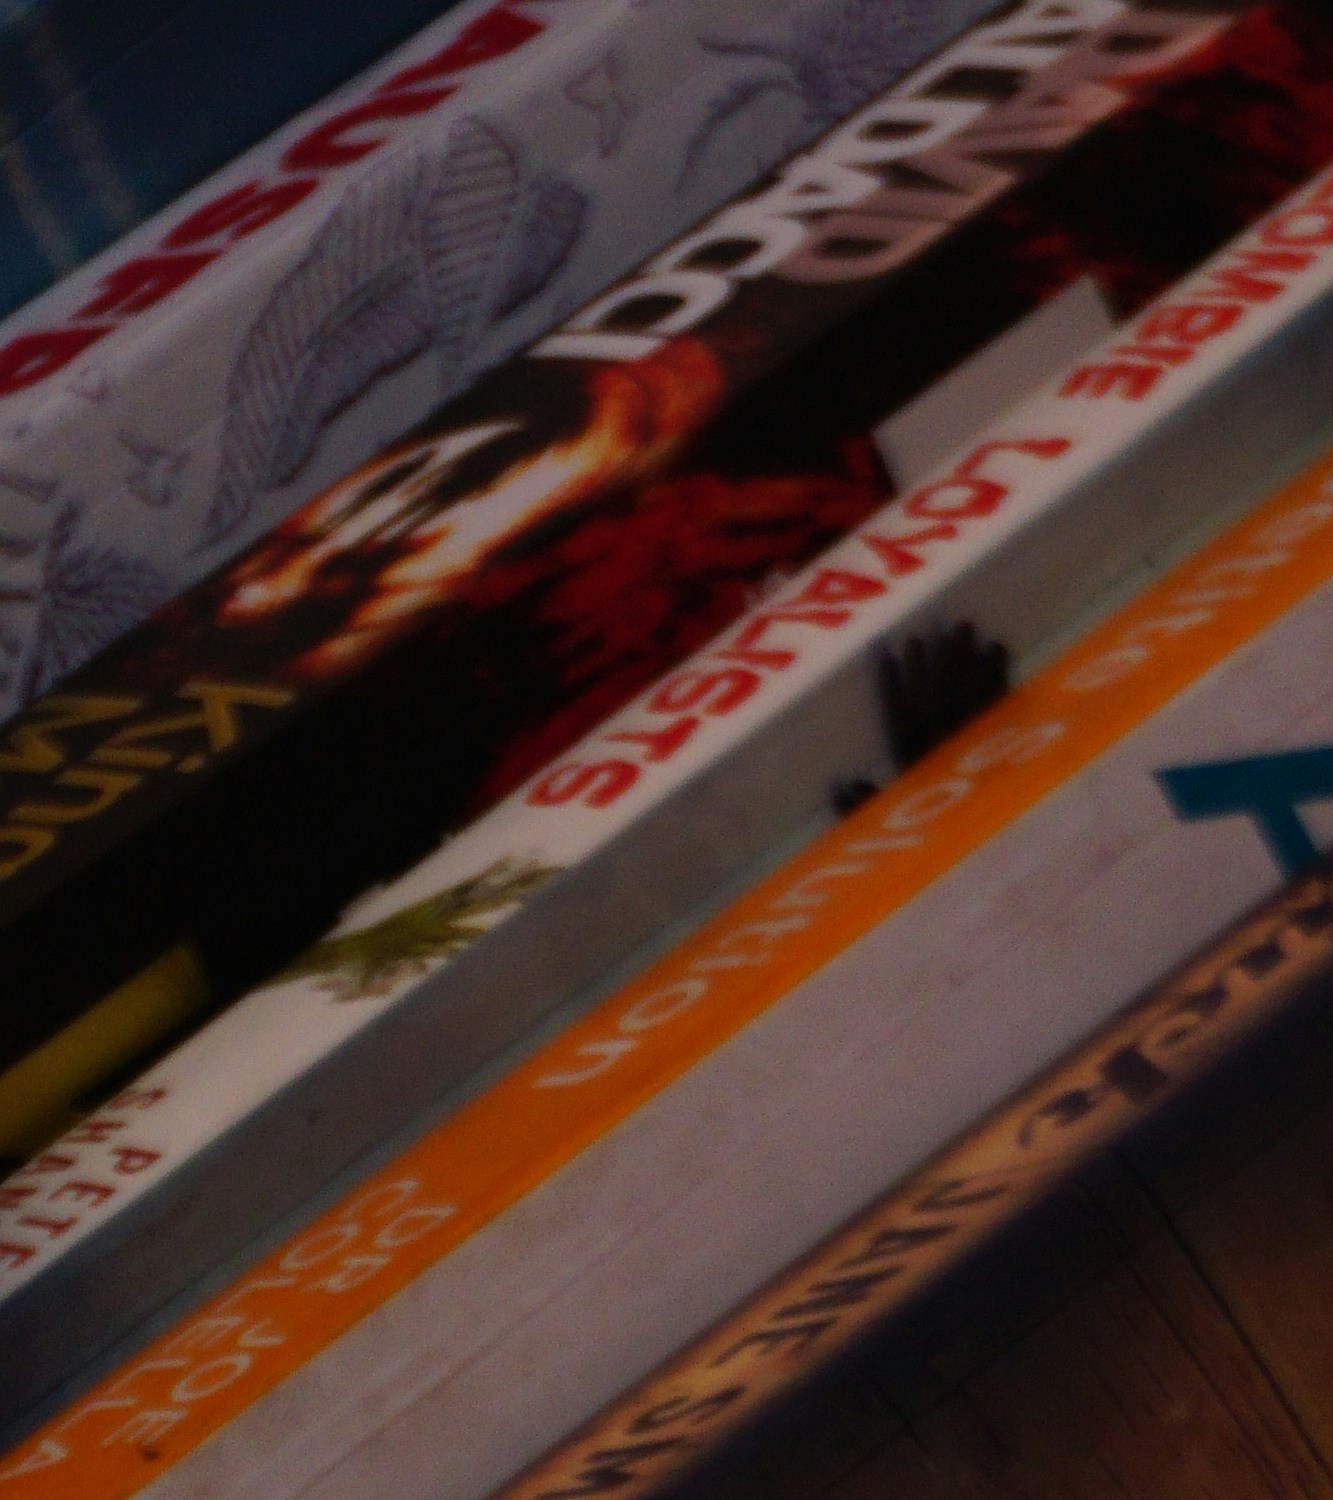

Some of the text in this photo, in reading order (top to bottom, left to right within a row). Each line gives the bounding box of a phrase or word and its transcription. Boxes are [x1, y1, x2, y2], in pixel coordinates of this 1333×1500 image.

[527, 437, 1070, 810] LOYALISTS
[535, 718, 1067, 1090] Solution
[0, 1176, 422, 1484] COLELLA
[100, 1200, 461, 1450] DR JOE
[712, 1160, 1008, 1368] JANE
